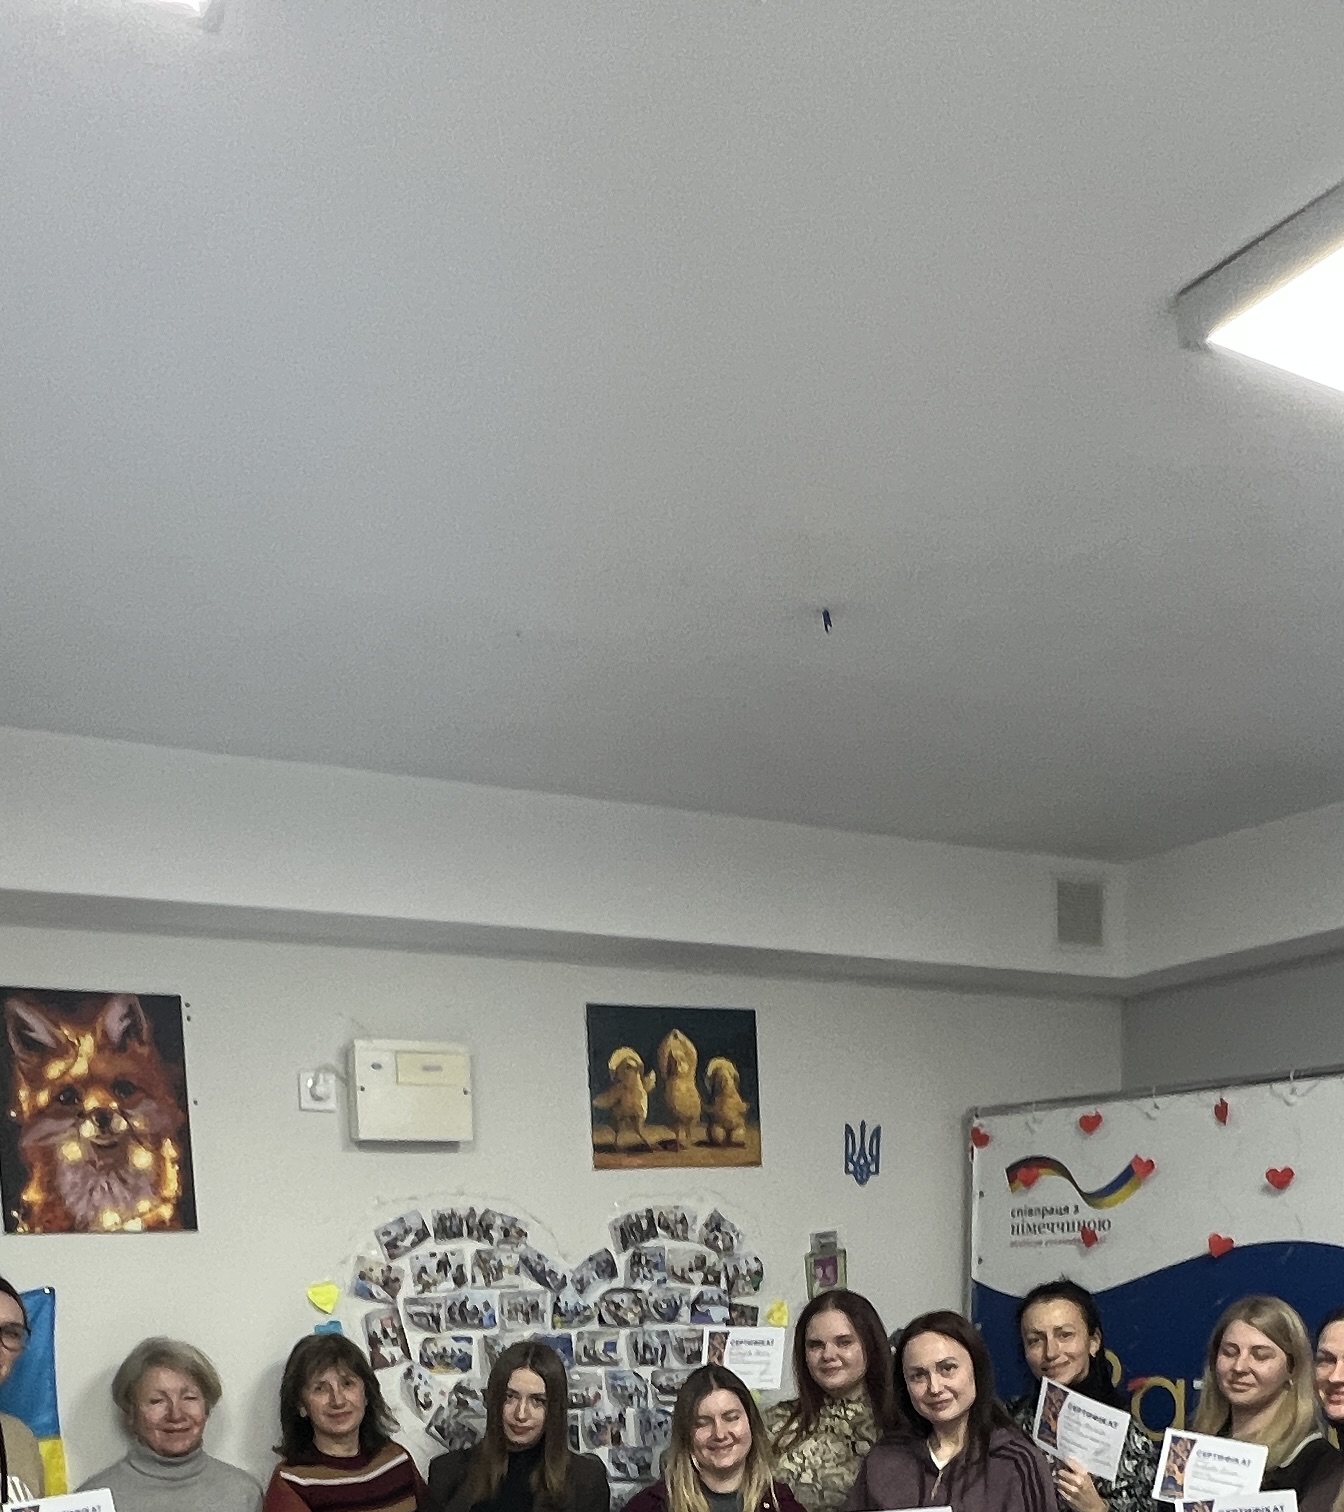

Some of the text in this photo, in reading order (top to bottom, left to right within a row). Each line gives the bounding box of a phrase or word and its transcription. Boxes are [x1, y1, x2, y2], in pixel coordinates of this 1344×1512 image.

[1011, 1204, 1080, 1219] співпраця з
[1067, 1402, 1119, 1430] СЕРТИФІКАТ
[1196, 1448, 1253, 1468] СЕРТИФІКАТ
